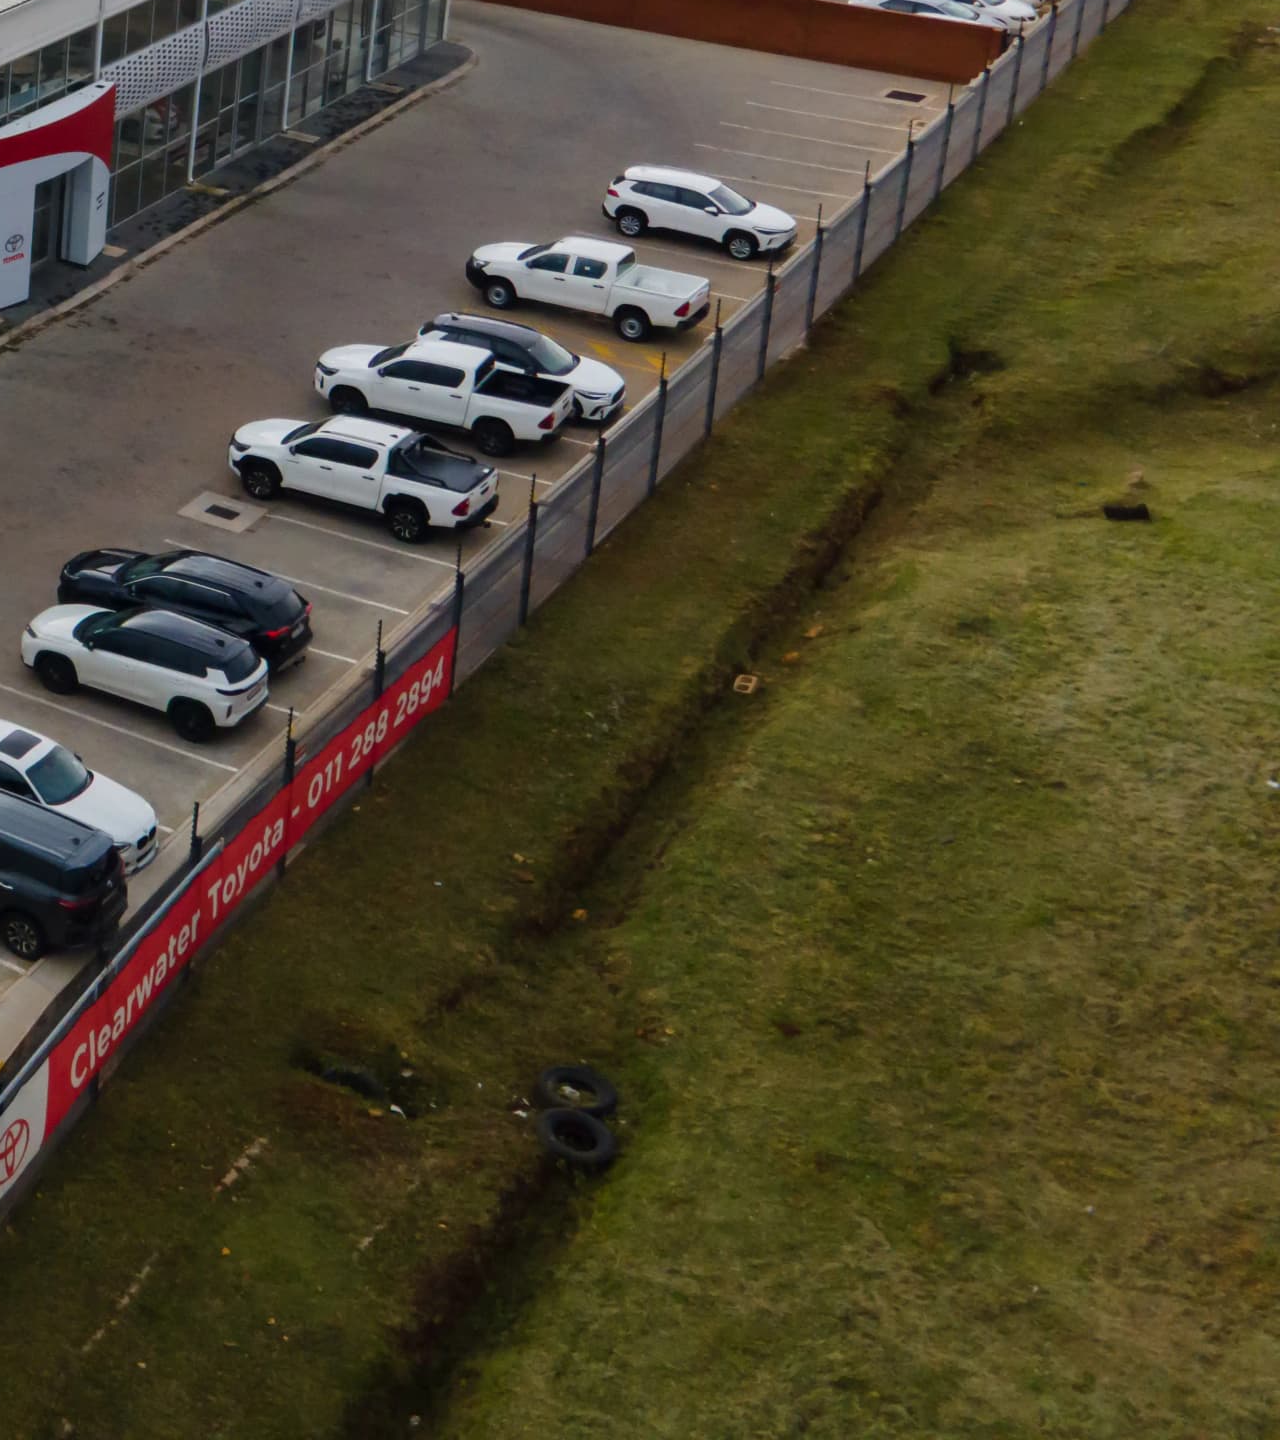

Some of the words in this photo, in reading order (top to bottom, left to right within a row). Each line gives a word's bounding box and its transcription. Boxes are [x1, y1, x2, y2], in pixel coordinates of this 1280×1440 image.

[70, 908, 200, 1089] Clearwater
[207, 817, 284, 919] Toyota
[307, 751, 343, 809] 011
[348, 709, 389, 770] 288
[393, 655, 444, 728] 2894
